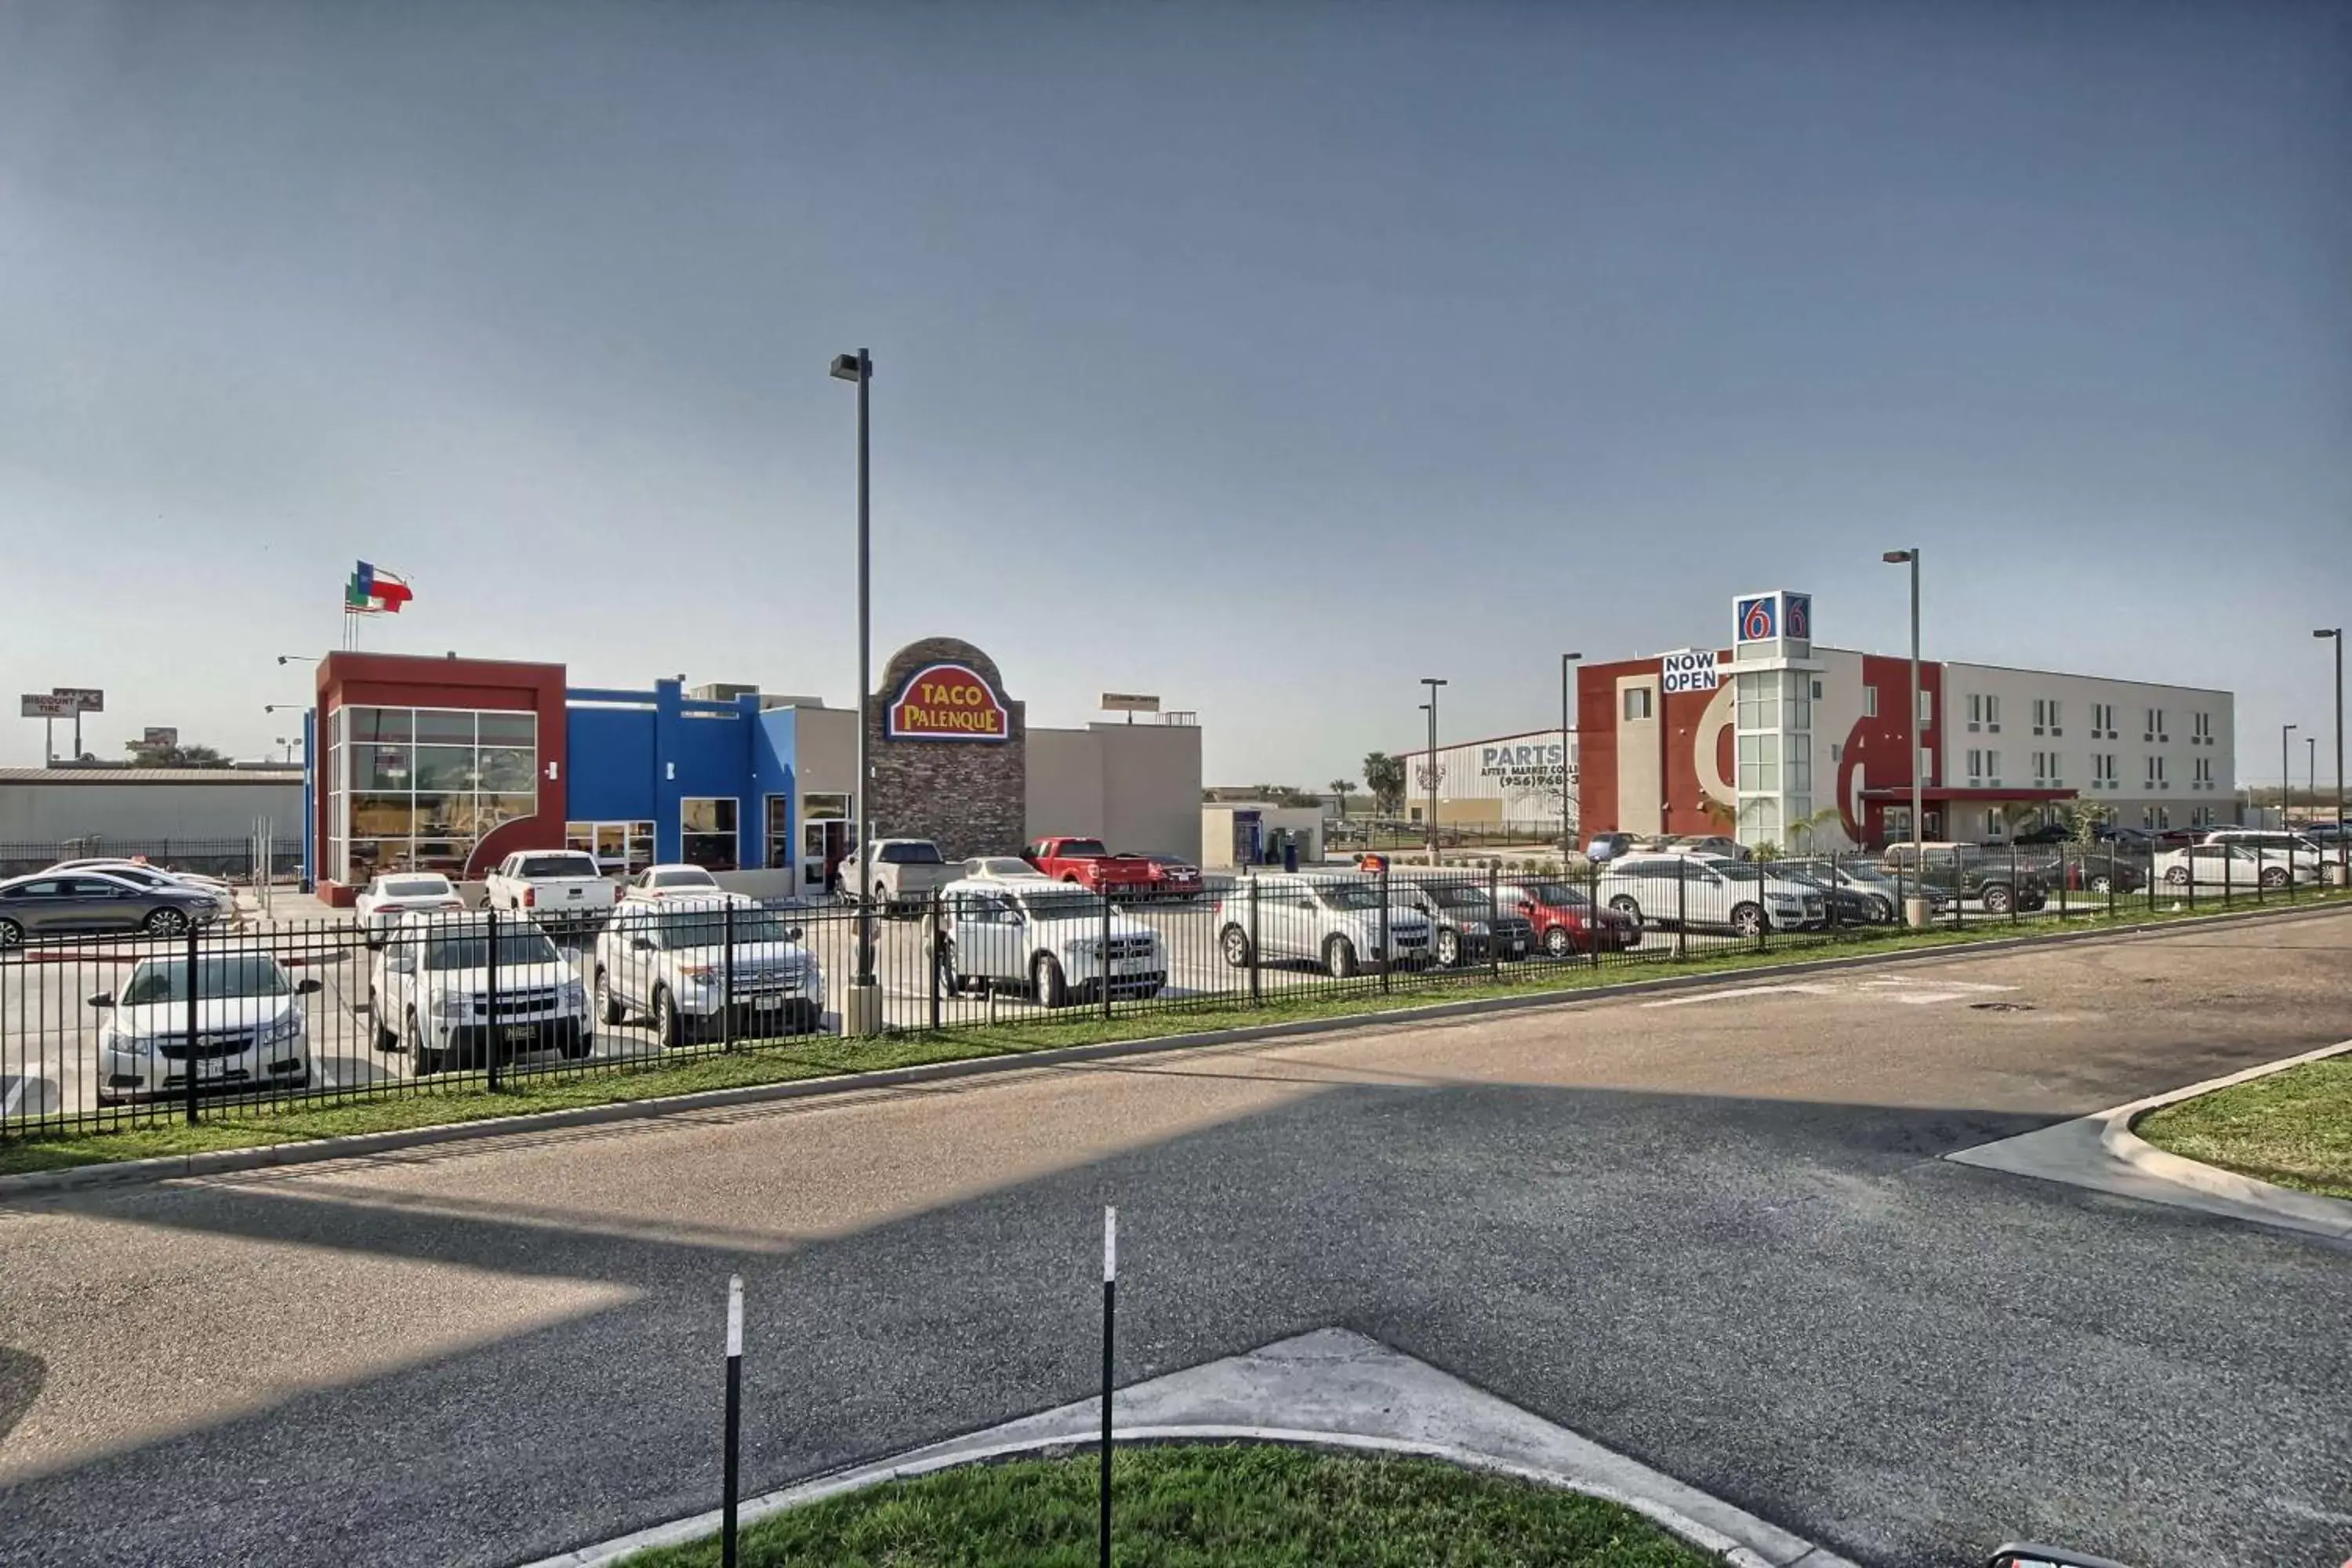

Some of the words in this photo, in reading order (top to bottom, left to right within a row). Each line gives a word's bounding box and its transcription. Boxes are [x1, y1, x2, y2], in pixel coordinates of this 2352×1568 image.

[1744, 599, 1771, 641] 6
[1788, 599, 1806, 637] 6
[1666, 652, 1715, 672] NOW
[1664, 670, 1716, 691] OPEN
[24, 695, 74, 706] DISCOUNT
[921, 683, 982, 706] TACO
[904, 704, 998, 732] PALENQUE
[1483, 745, 1563, 767] PARTS
[1481, 768, 1507, 776] AFTER
[1511, 765, 1548, 775] MARKET
